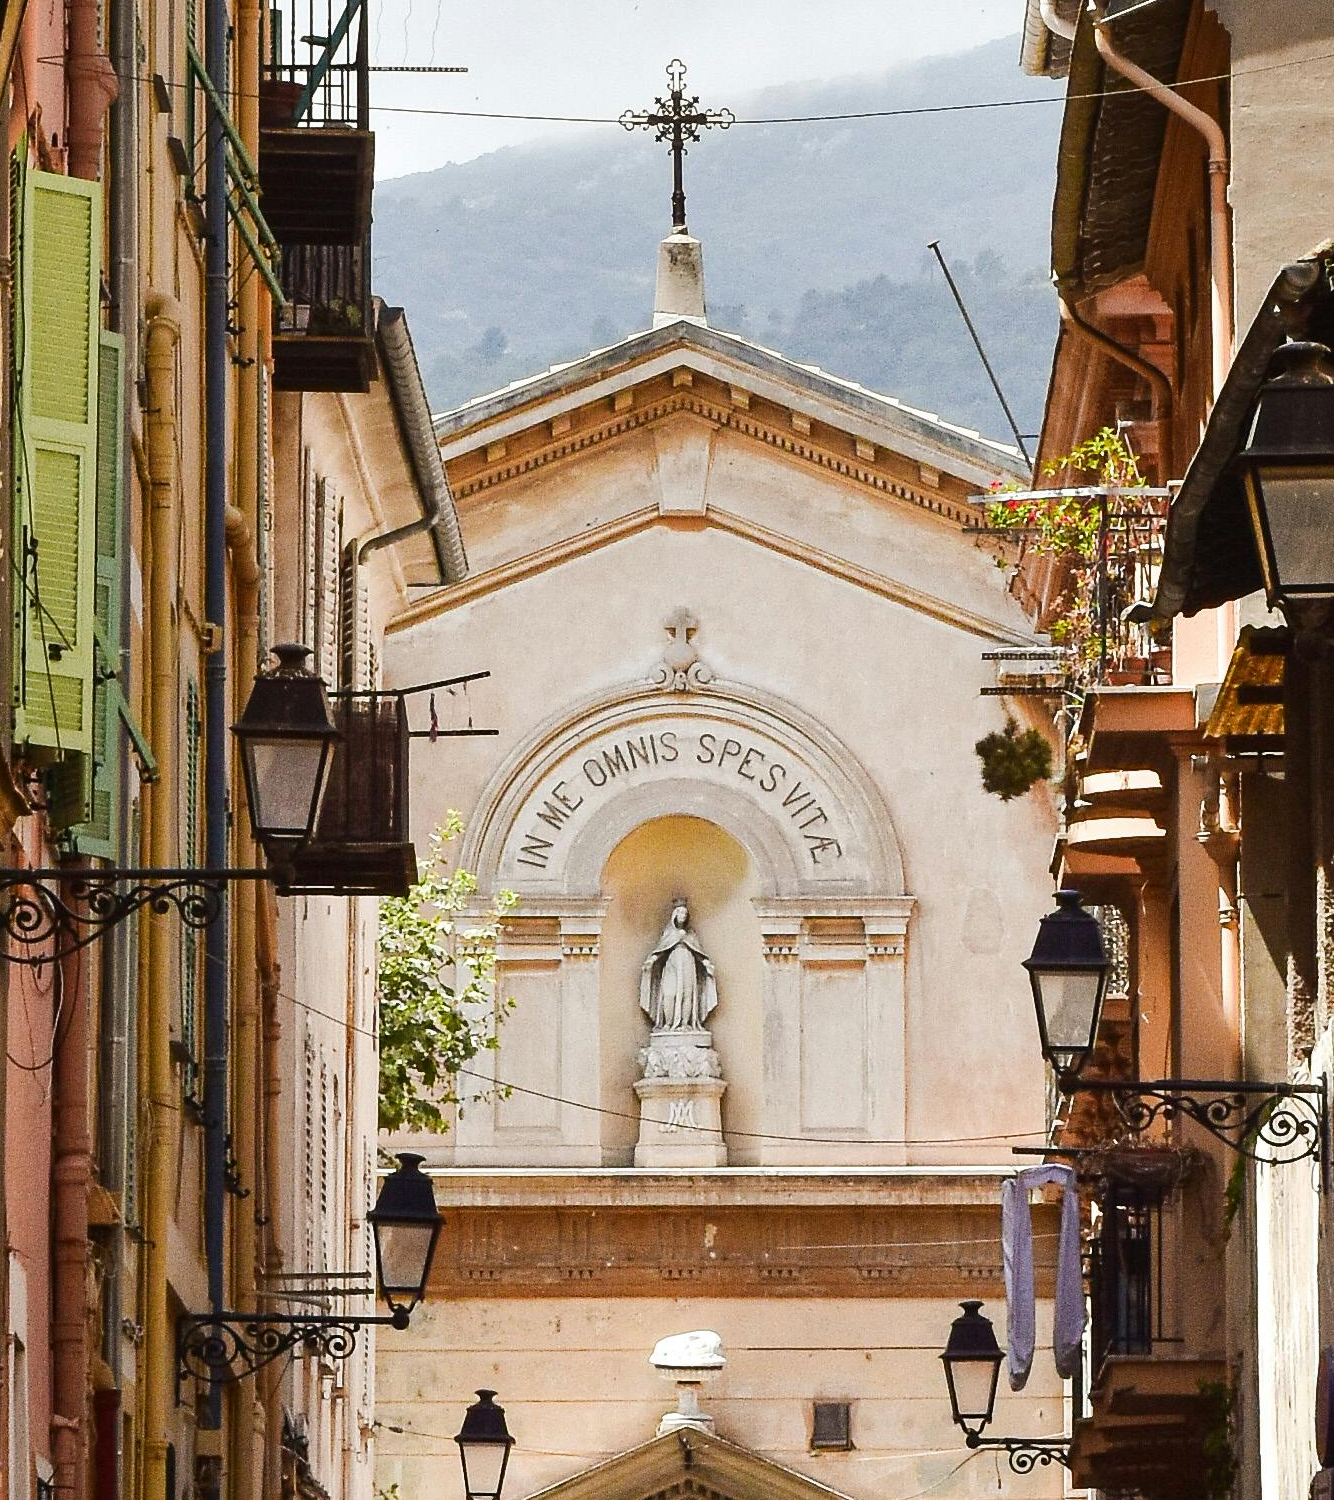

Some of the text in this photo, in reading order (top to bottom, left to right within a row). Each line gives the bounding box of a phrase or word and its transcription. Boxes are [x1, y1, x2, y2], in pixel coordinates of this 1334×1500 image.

[517, 834, 554, 868] IN
[536, 781, 584, 831] ME
[582, 732, 679, 787] OMNIS
[696, 733, 787, 792] SPES
